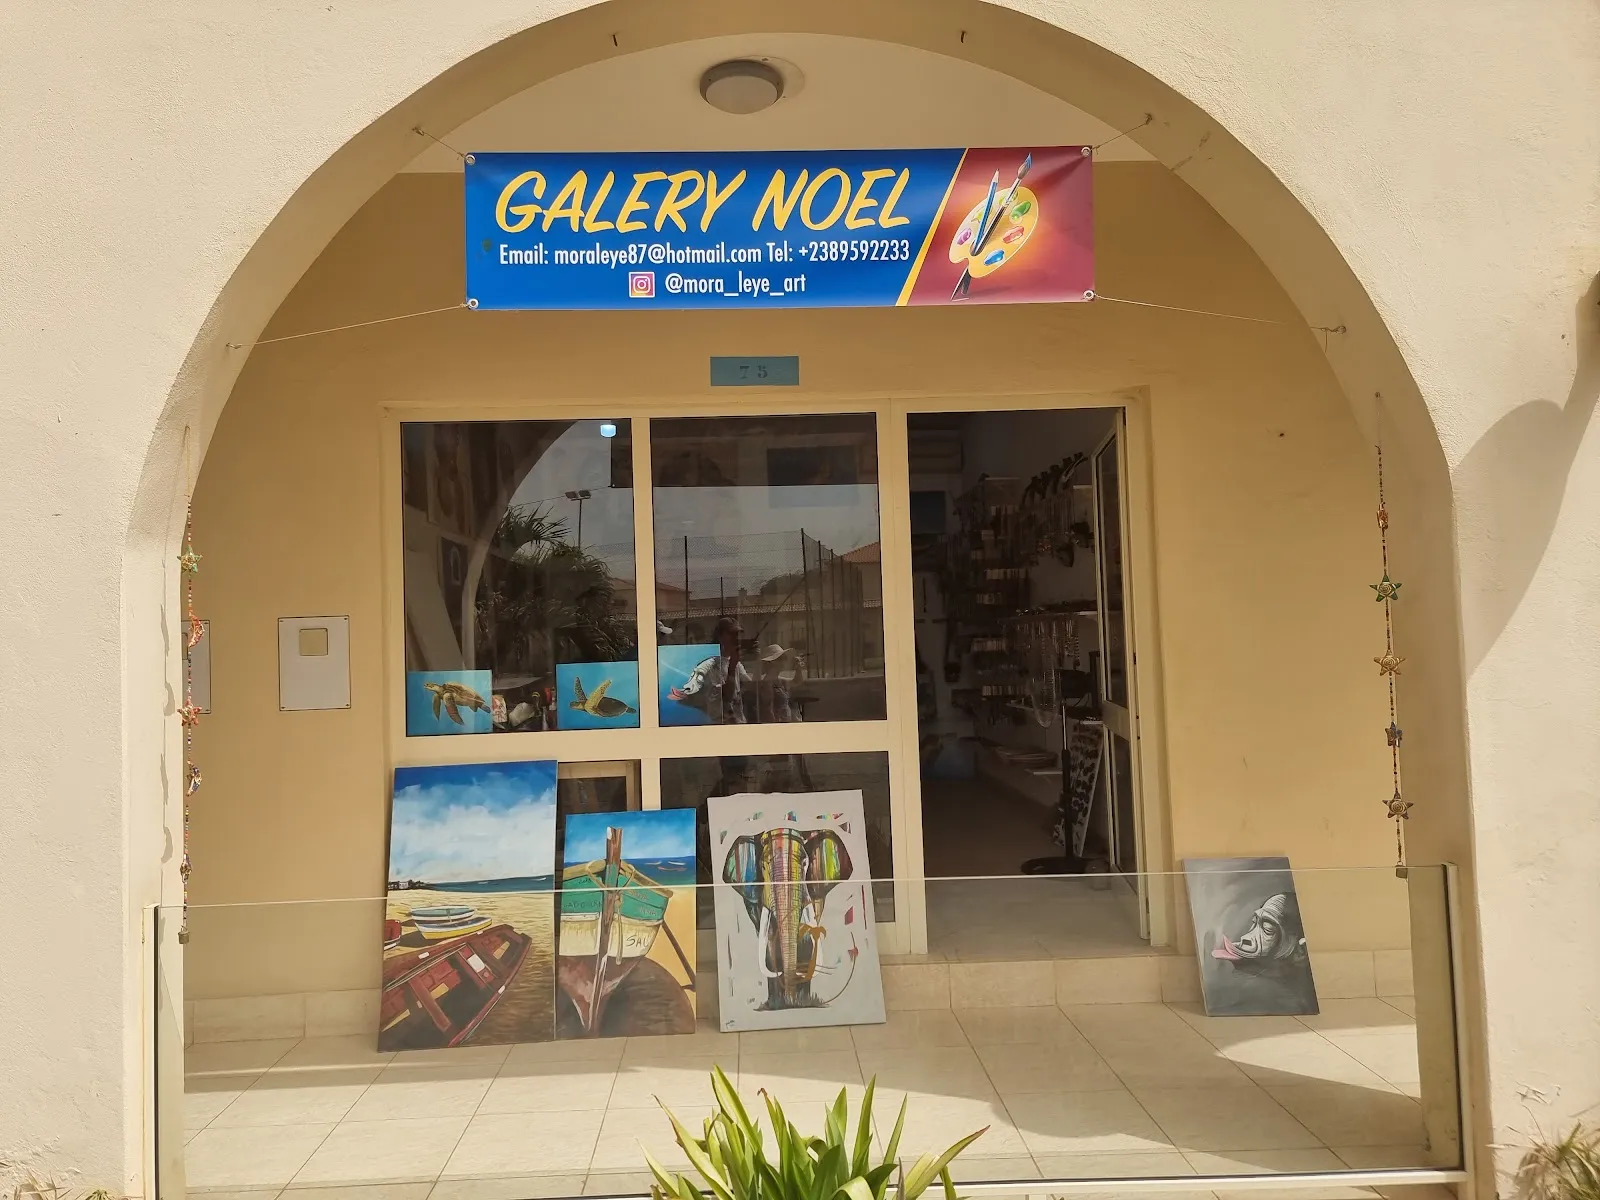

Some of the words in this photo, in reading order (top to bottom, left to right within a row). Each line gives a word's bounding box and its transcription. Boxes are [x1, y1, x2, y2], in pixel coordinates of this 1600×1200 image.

[495, 169, 747, 233] GALERY
[752, 167, 910, 232] NOEL
[499, 242, 550, 266] Email:
[554, 241, 762, 269] moraleye87@hotmail.com
[766, 240, 794, 263] Tel:
[798, 239, 910, 262] +2389592233
[664, 270, 807, 297] @mora_leye_art
[739, 364, 769, 380] 75
